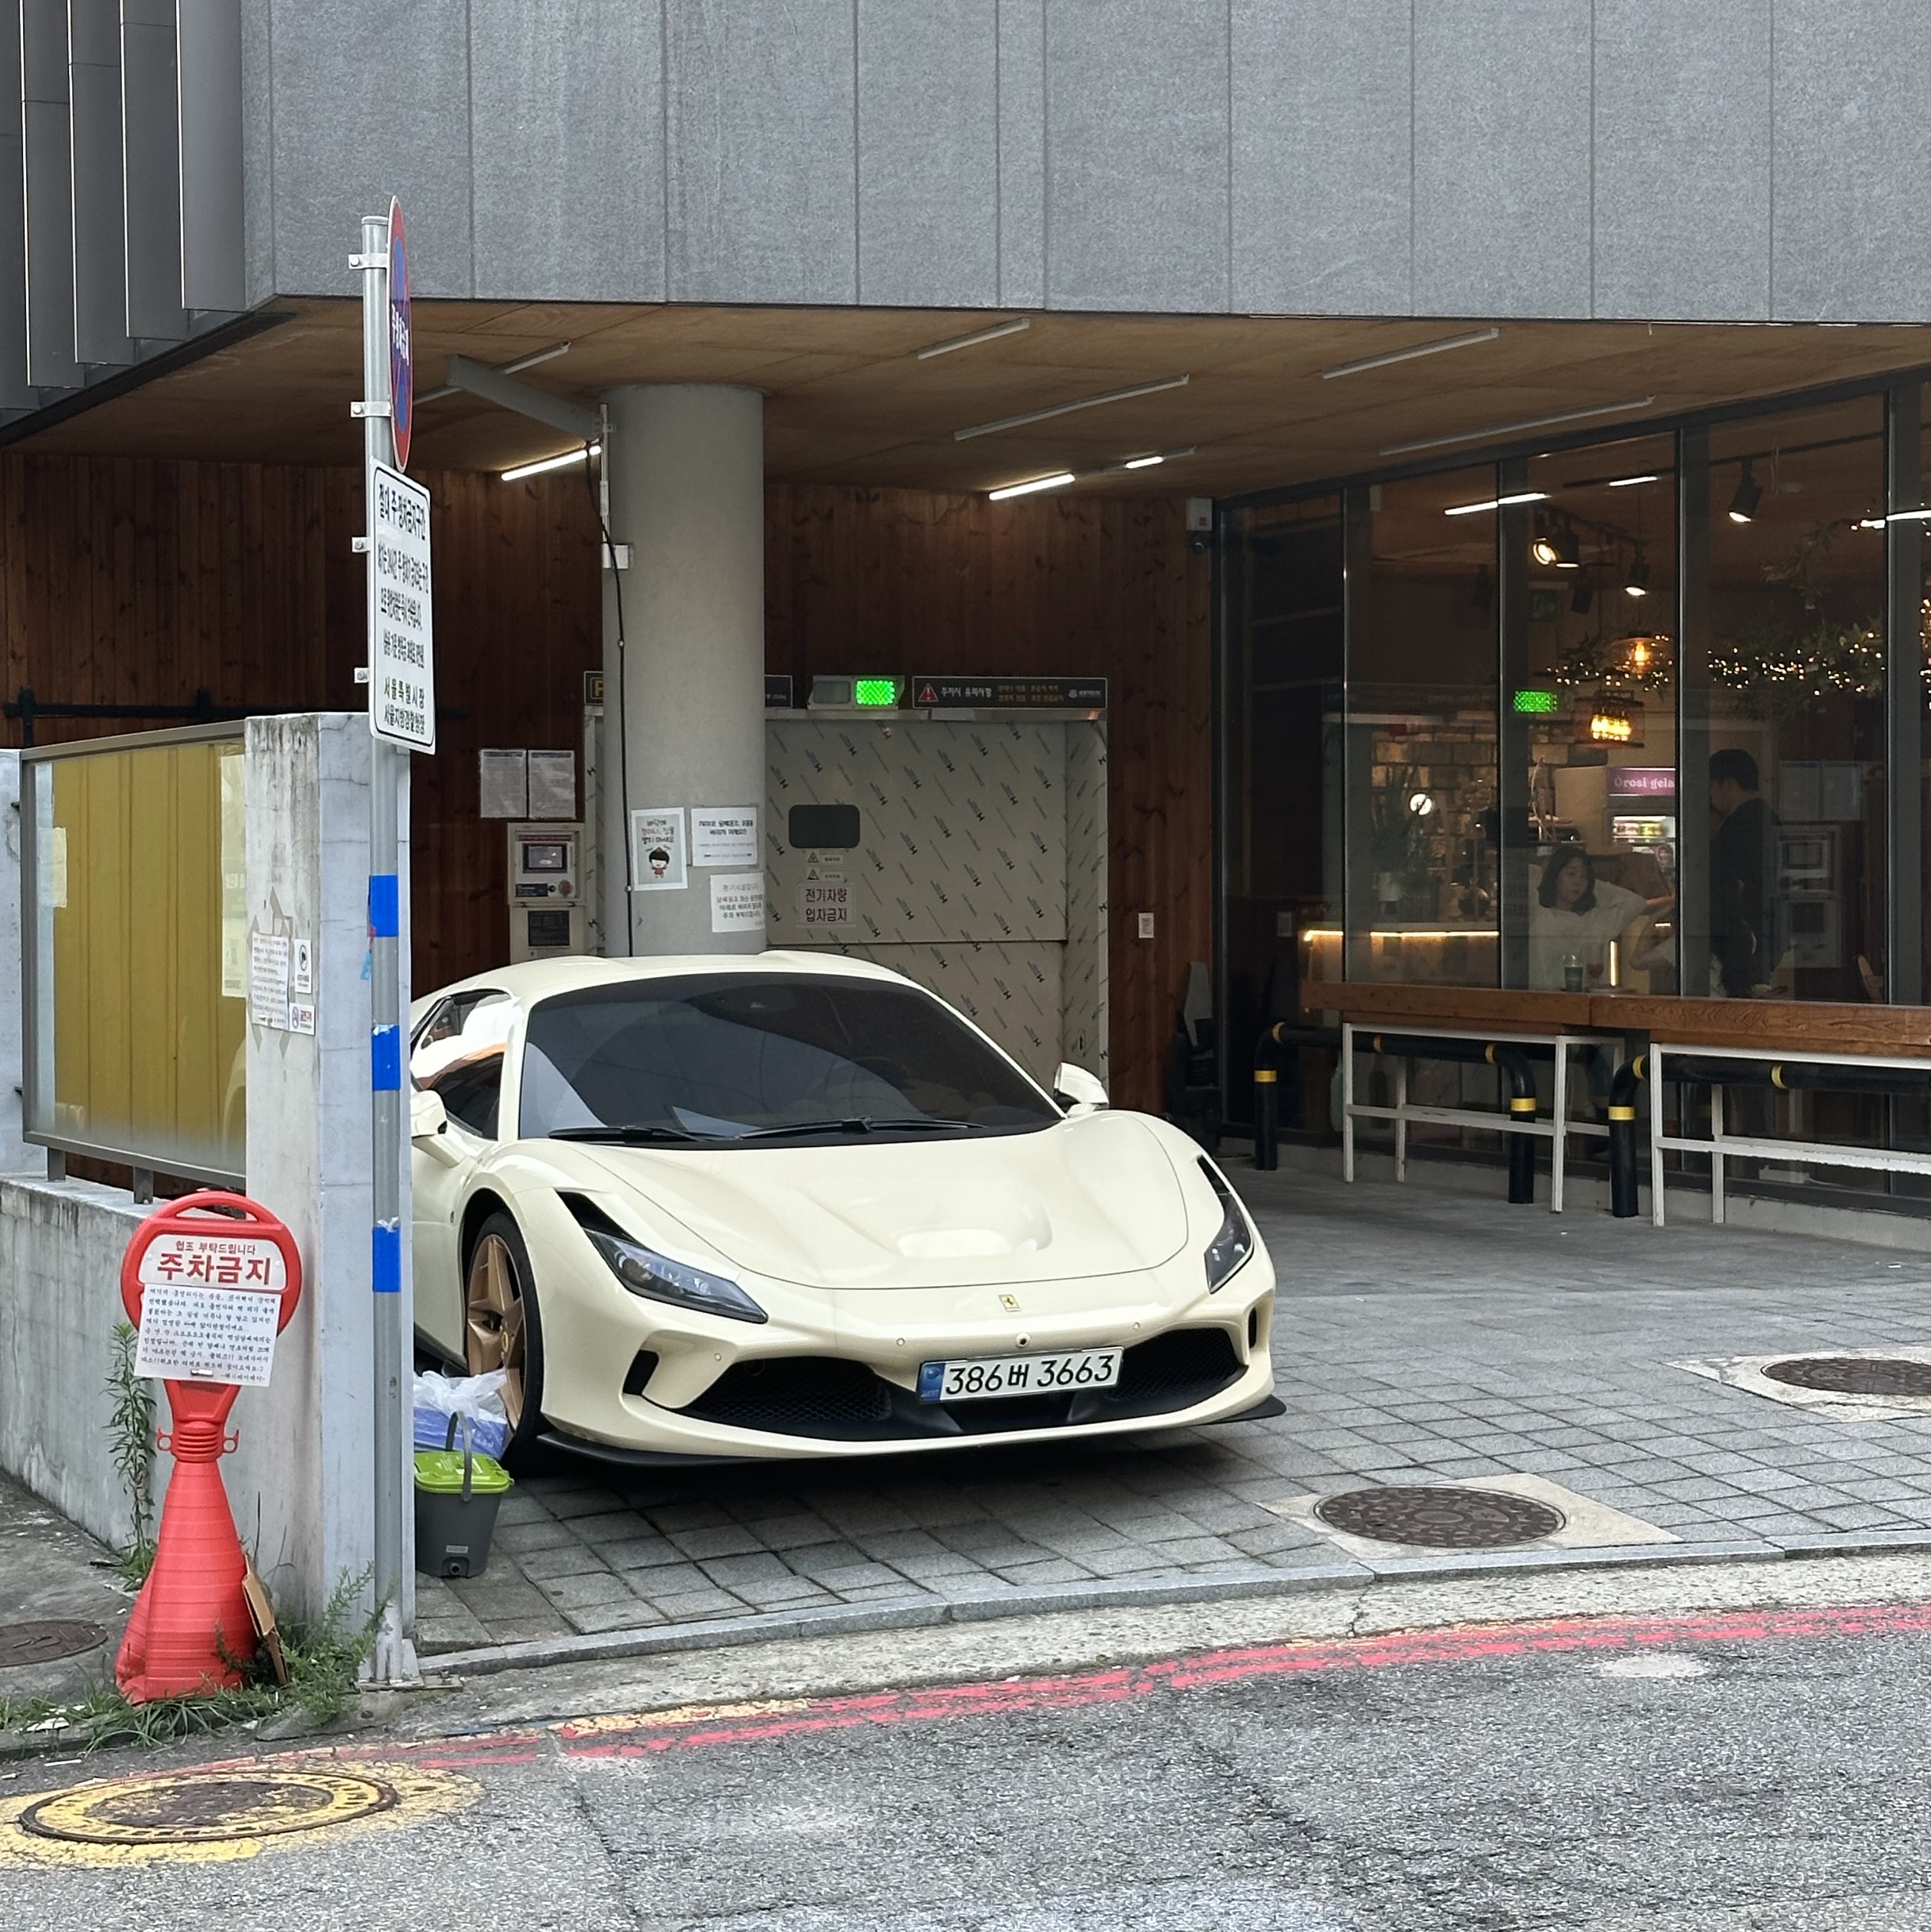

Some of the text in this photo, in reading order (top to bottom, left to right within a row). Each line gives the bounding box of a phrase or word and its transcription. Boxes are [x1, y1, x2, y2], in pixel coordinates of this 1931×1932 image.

[805, 888, 848, 902] 전기차량
[805, 908, 848, 922] 입차금지
[176, 1240, 257, 1256] 협조 부탁드립니다
[157, 1253, 271, 1286] 주차금지
[945, 1354, 1115, 1395] 386버 3663
